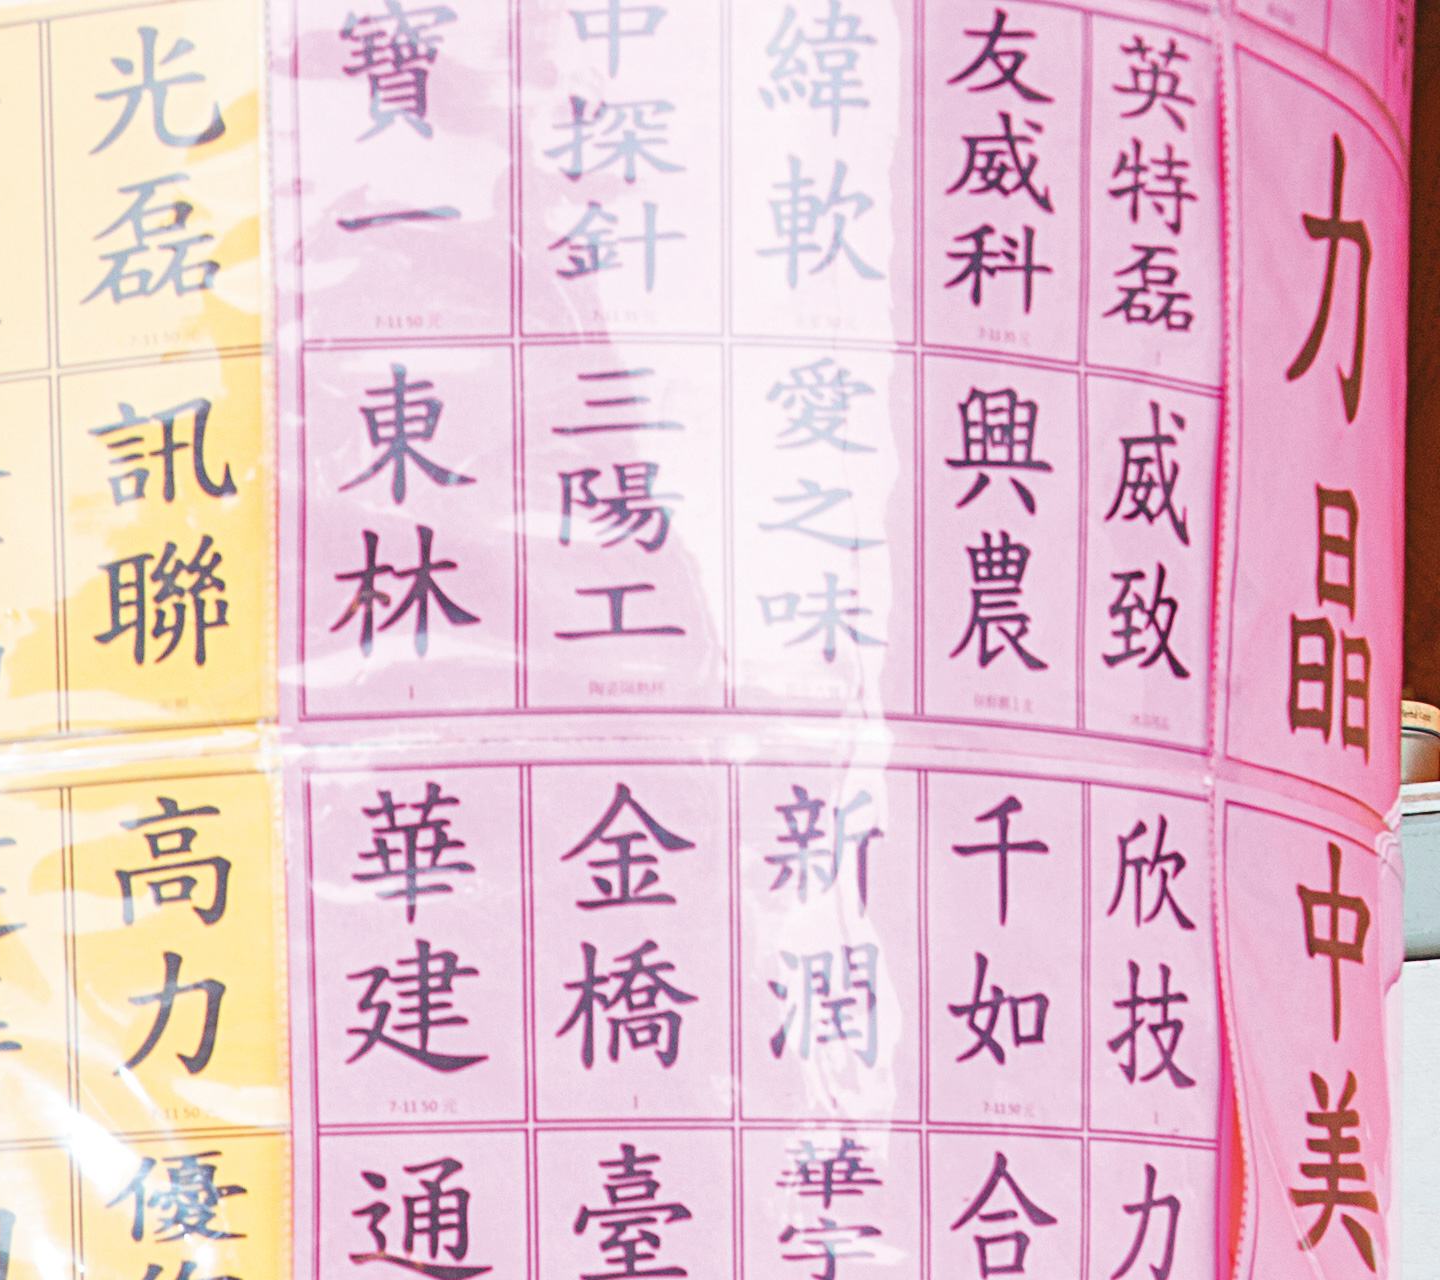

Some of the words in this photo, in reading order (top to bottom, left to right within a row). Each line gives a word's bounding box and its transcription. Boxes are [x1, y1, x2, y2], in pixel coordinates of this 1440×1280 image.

[81, 25, 226, 305] 光磊
[545, 0, 688, 293] 中探針
[944, 9, 1055, 315] 友威科
[1106, 34, 1198, 334] 英特磊
[88, 398, 237, 667] 訊聯
[329, 363, 481, 658] 東林
[551, 367, 686, 640] 三陽工
[756, 357, 889, 664] 愛之味
[944, 387, 1053, 673] 興農
[1102, 399, 1191, 682] 威致
[1285, 131, 1374, 765] 力晶
[112, 796, 231, 1077] 高力
[344, 781, 490, 1073] 華建
[557, 781, 699, 1071] 金橋
[762, 783, 887, 1069] 新潤
[947, 794, 1051, 1067] 千如
[1105, 813, 1198, 1091] 欣技
